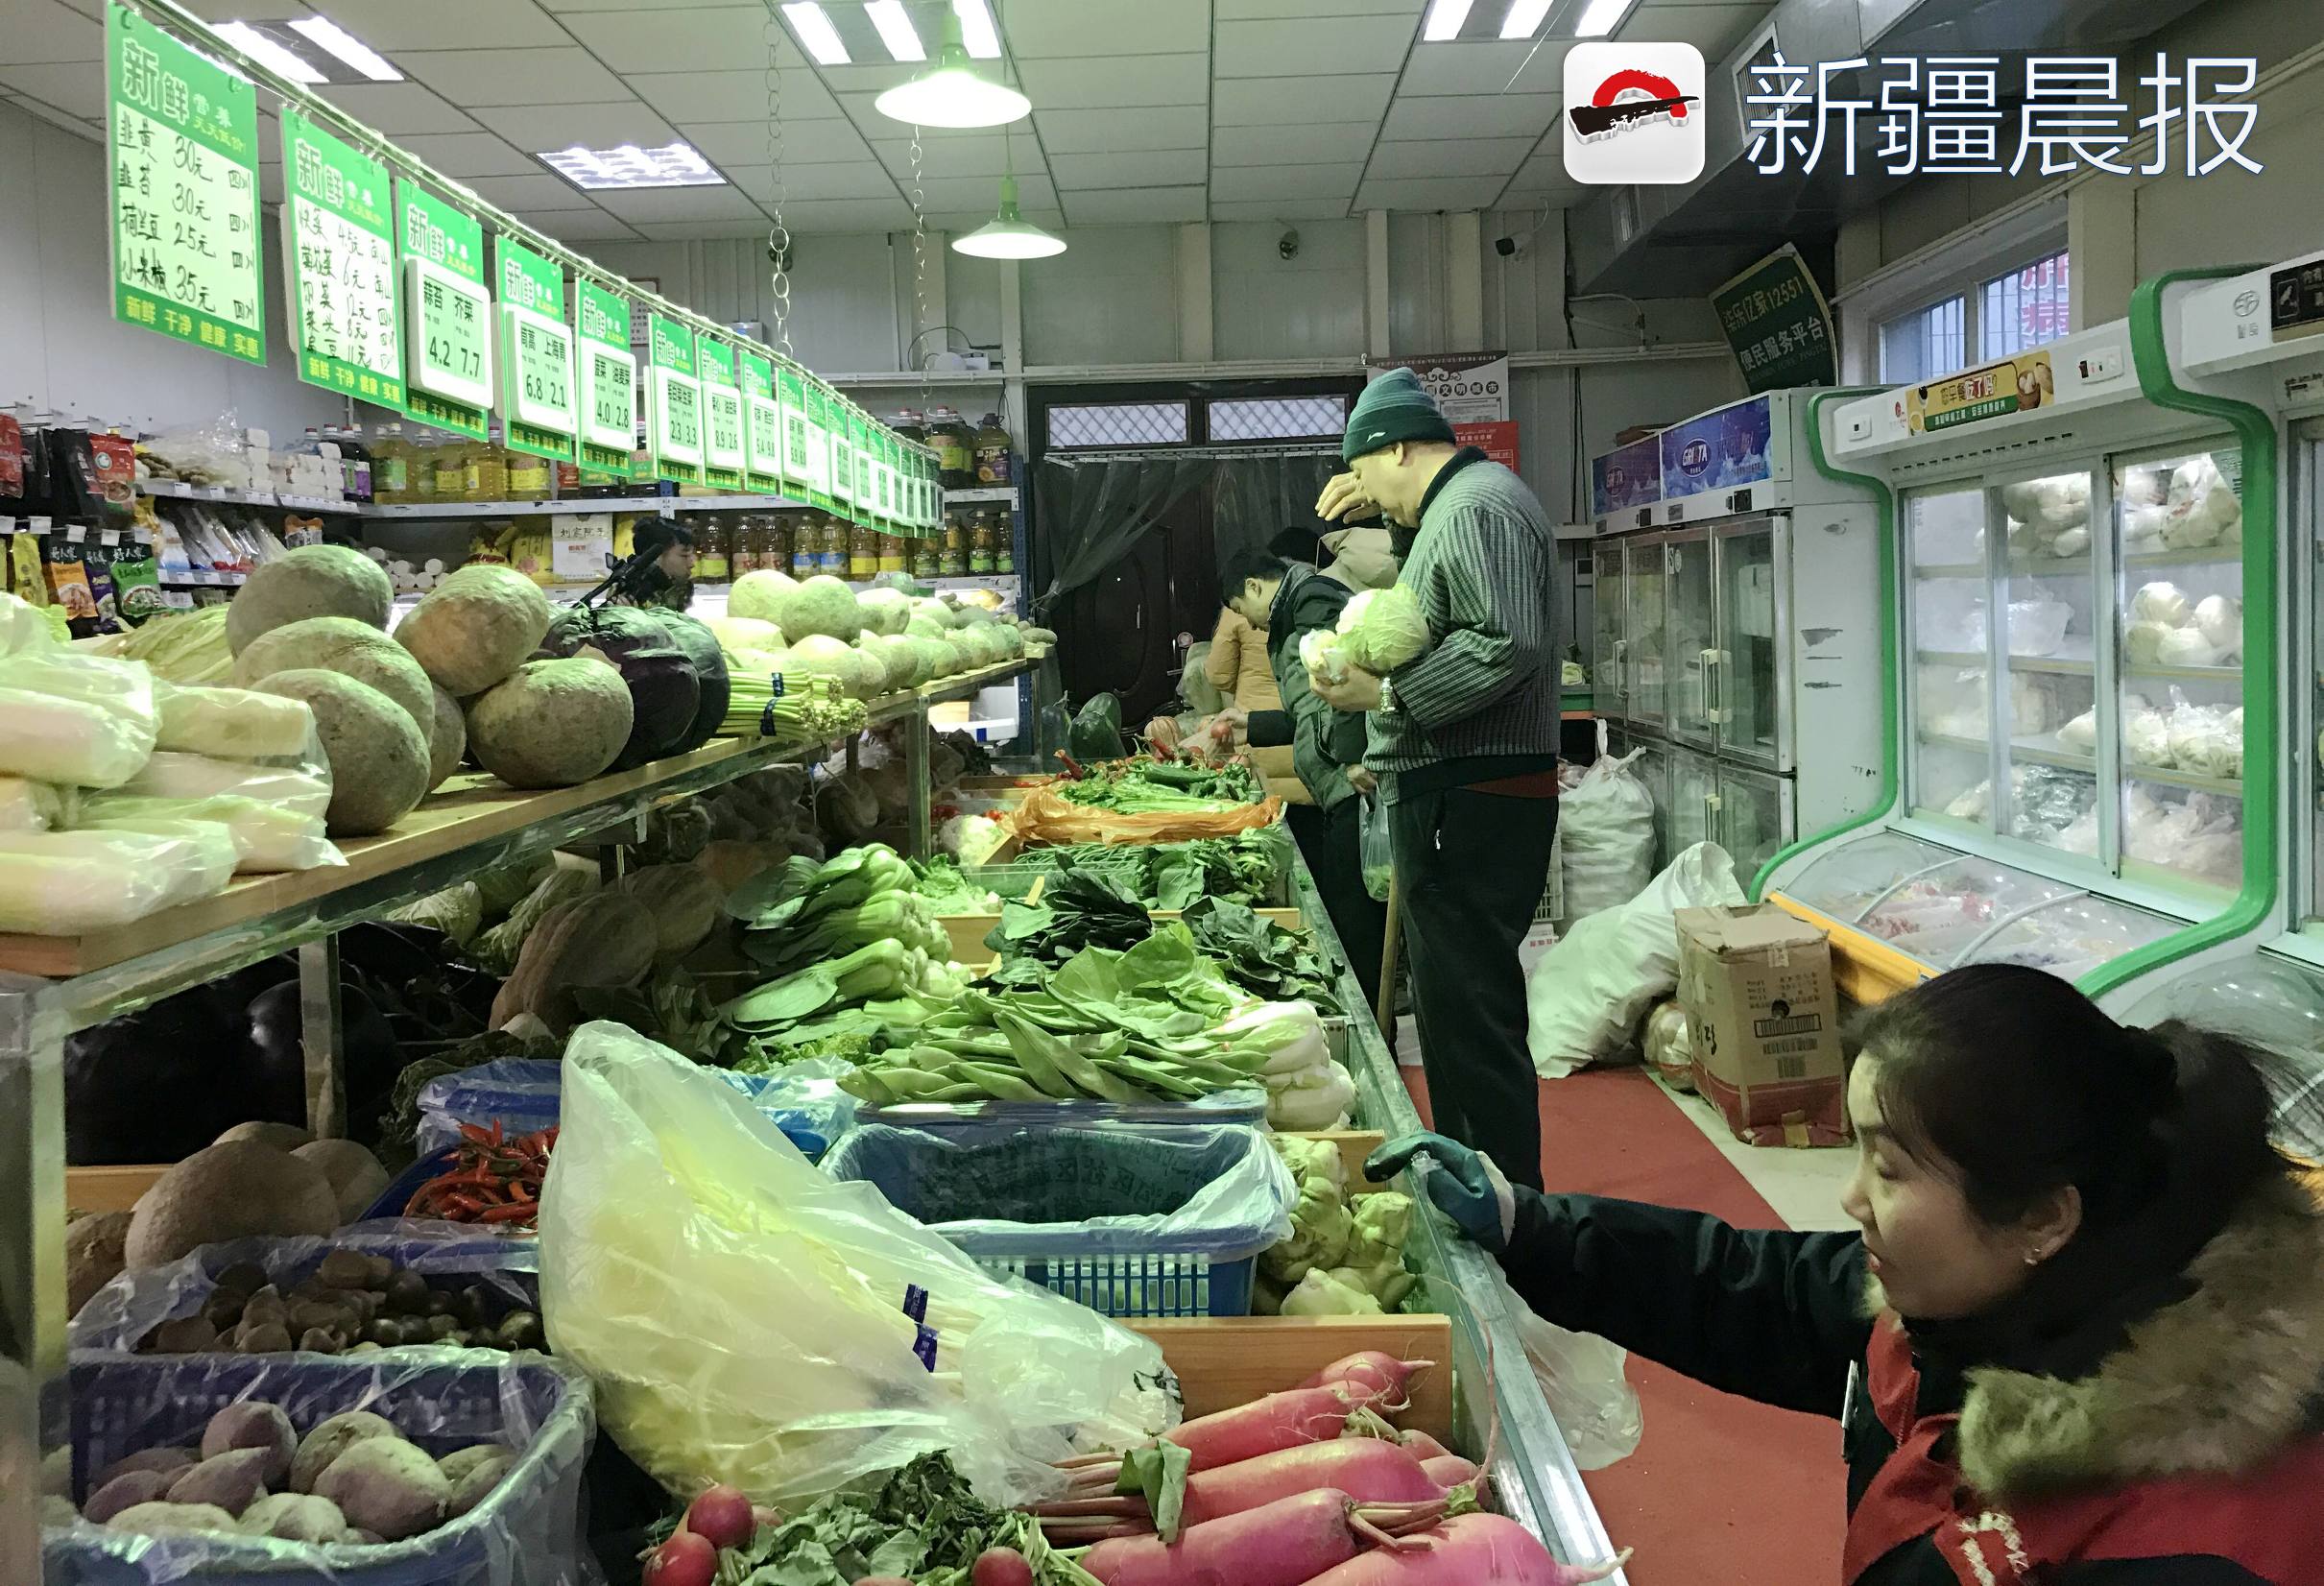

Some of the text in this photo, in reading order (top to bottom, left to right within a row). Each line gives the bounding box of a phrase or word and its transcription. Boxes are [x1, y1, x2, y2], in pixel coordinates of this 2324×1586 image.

[122, 37, 189, 126] 新鲜
[174, 135, 213, 181] 30元
[295, 137, 345, 209] 新鲜
[172, 182, 211, 221] 30元
[174, 222, 216, 258] 25元
[407, 203, 445, 263] 新鲜
[174, 264, 216, 313] 35元
[126, 296, 156, 324] 新鲜
[164, 308, 192, 336] 干净
[429, 336, 480, 377] 4.2 7.7
[1739, 316, 1824, 372] 便民服务平台
[526, 374, 566, 408] 6.8 2.1
[597, 400, 629, 428] 4.0 2.8
[671, 421, 697, 445] 2.3 3.3
